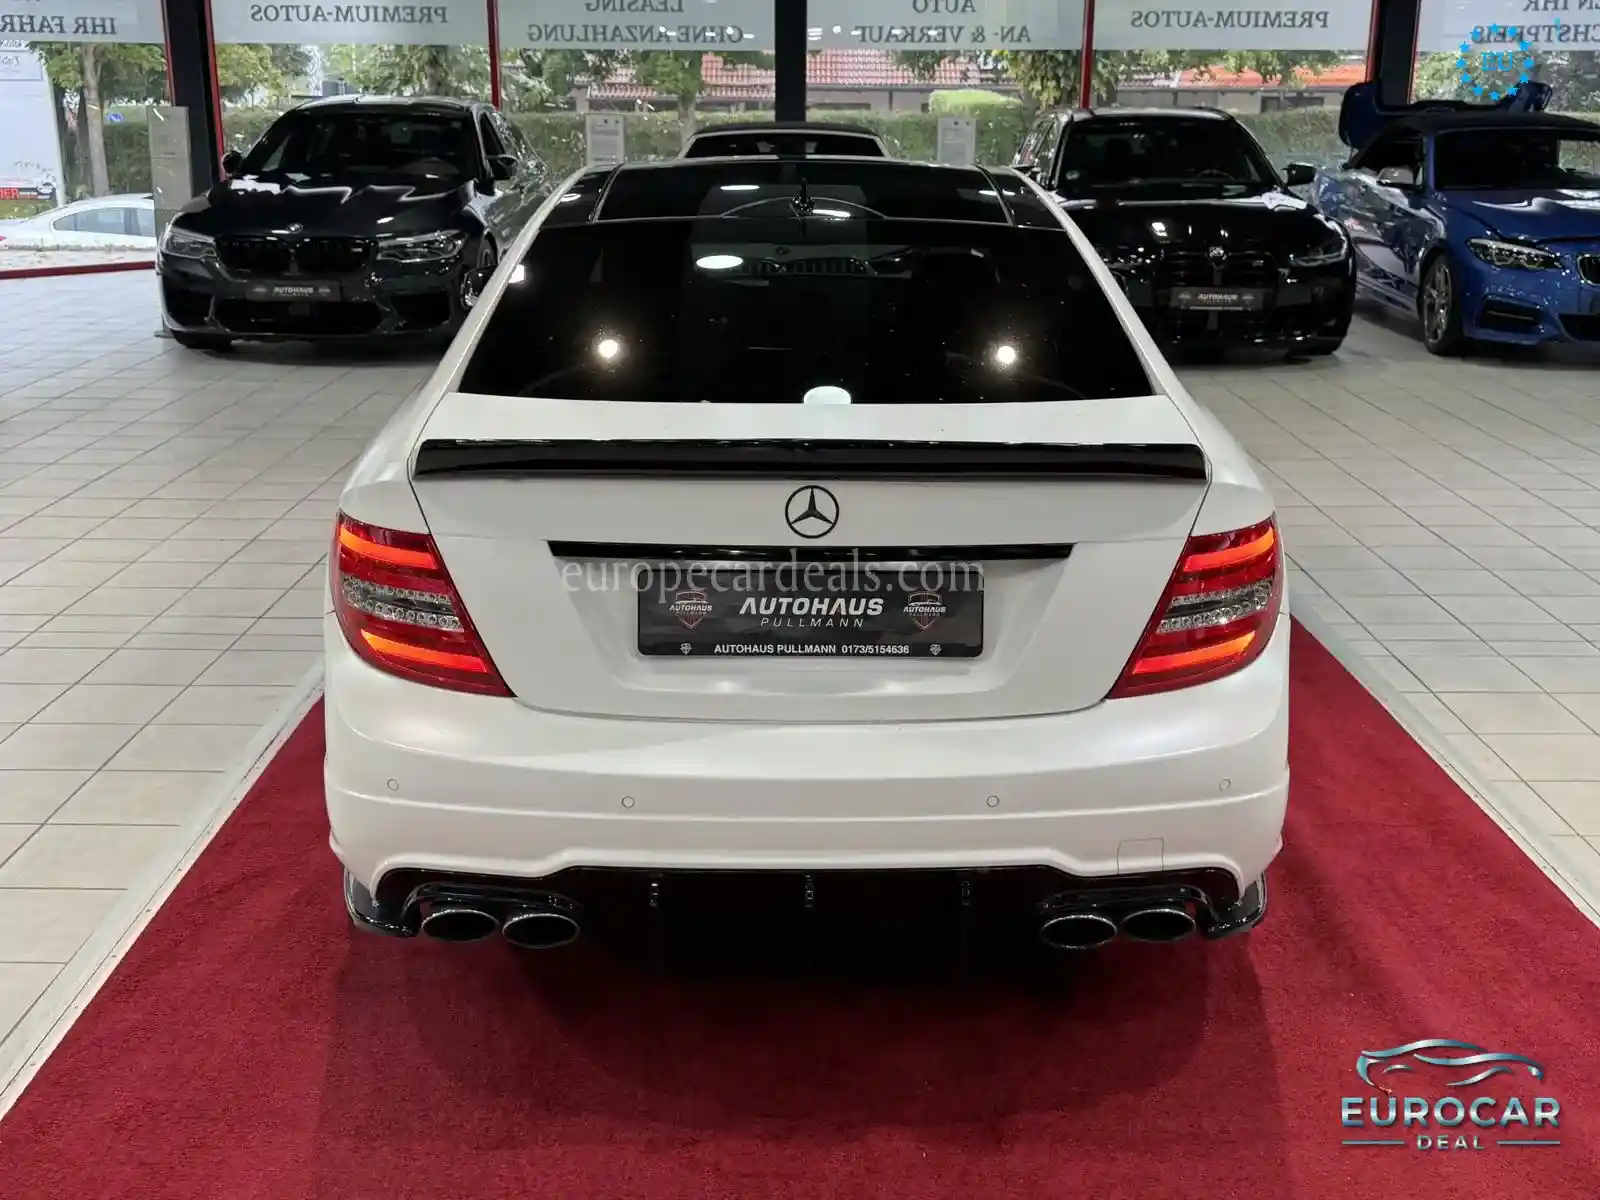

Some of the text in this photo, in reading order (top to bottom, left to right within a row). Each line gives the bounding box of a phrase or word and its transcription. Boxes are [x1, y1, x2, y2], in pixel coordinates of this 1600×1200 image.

[669, 604, 713, 612] AUTOHAUS
[739, 597, 884, 616] AUTOHAUS
[760, 617, 864, 628] PULLMANN
[714, 644, 910, 654] AUTOHAUS PULLMANN 0173/5154636
